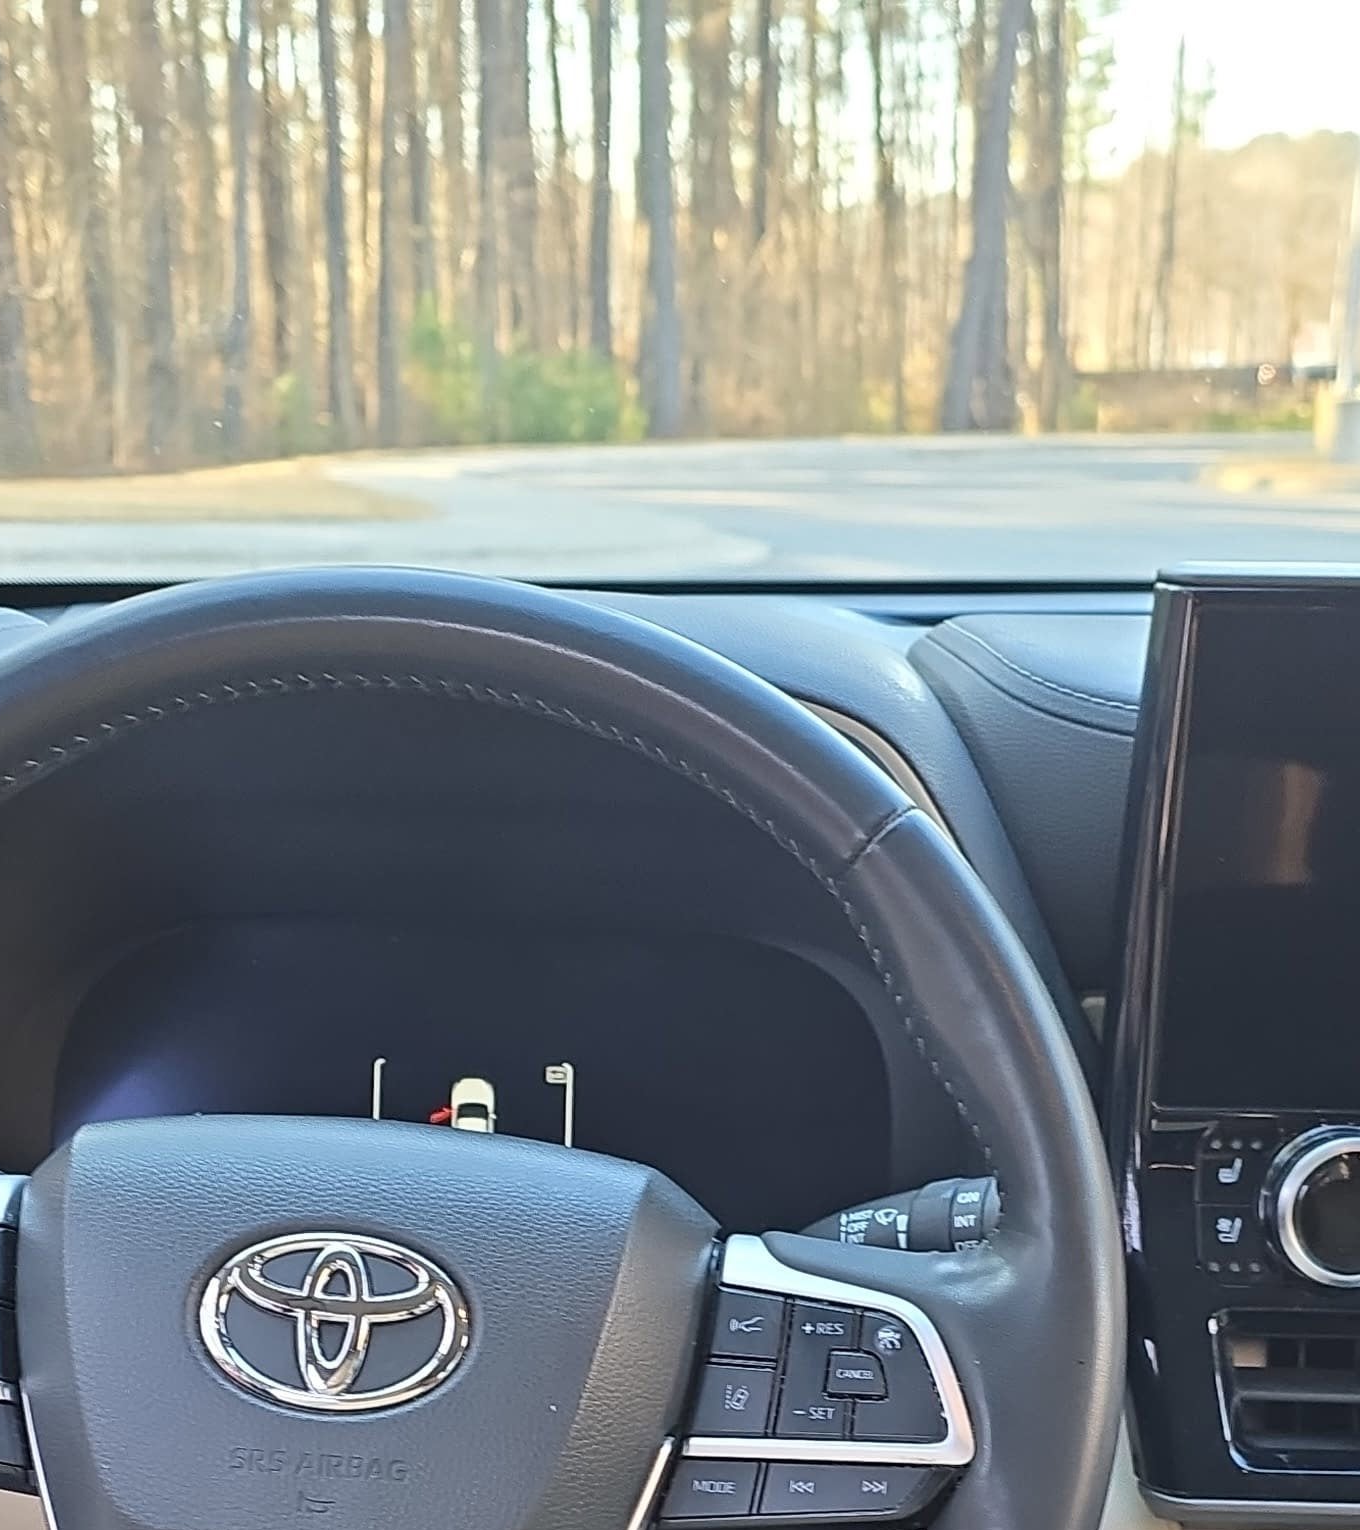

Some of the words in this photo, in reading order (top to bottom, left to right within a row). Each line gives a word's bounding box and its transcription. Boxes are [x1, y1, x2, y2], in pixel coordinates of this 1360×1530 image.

[957, 1192, 980, 1204] ON
[954, 1214, 977, 1228] INT
[836, 1369, 874, 1381] CANCEL
[230, 1447, 288, 1472] SRS
[295, 1453, 409, 1482] AIRBAG
[693, 1480, 737, 1495] MODE
